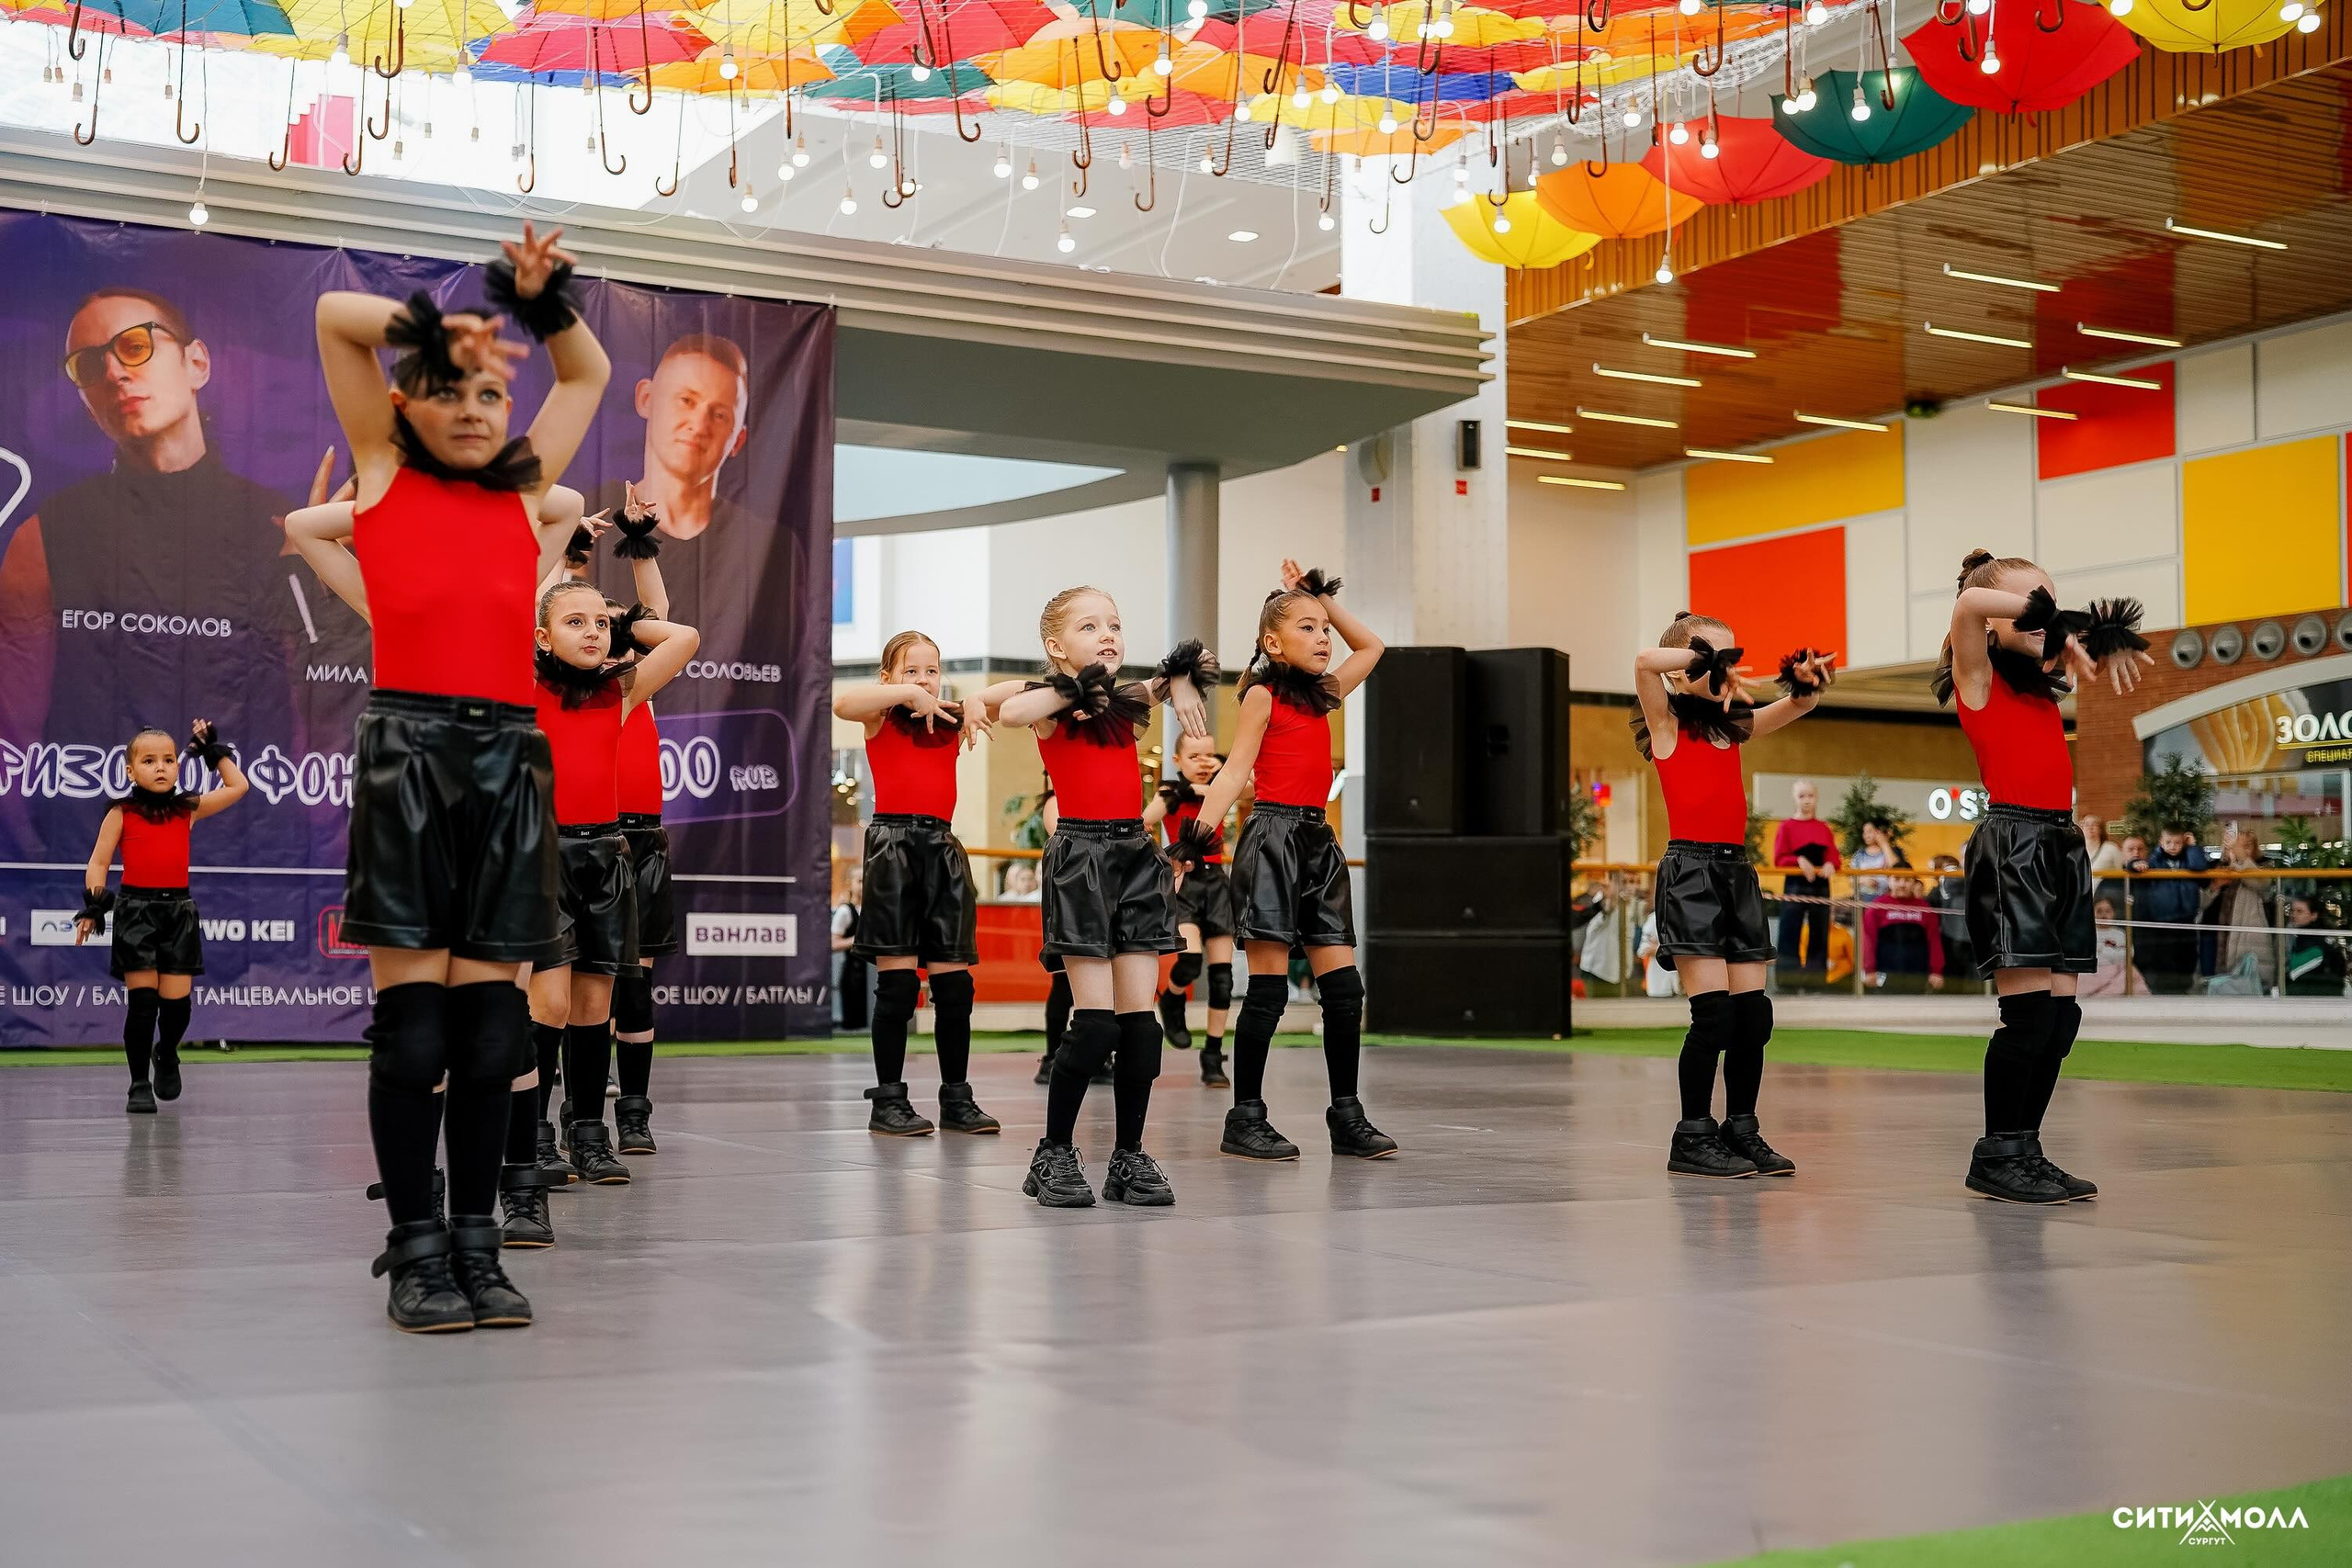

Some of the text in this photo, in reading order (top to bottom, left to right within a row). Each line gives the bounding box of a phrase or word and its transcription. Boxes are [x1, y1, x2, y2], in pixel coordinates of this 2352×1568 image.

[62, 609, 232, 637] ЕГОР СОКОЛОВ
[306, 663, 368, 684] МИЛА
[686, 660, 782, 683] СОЛОВЬЕВ
[729, 764, 780, 792] RUB
[198, 919, 295, 942] WO KEI
[695, 927, 786, 943] ванлав
[12, 986, 69, 1006] ШОУ
[194, 987, 363, 1008] ТАНЦЕВАЛЬНОЕ
[684, 986, 730, 1006] ШОУ
[746, 986, 813, 1005] БАТТЛЫ
